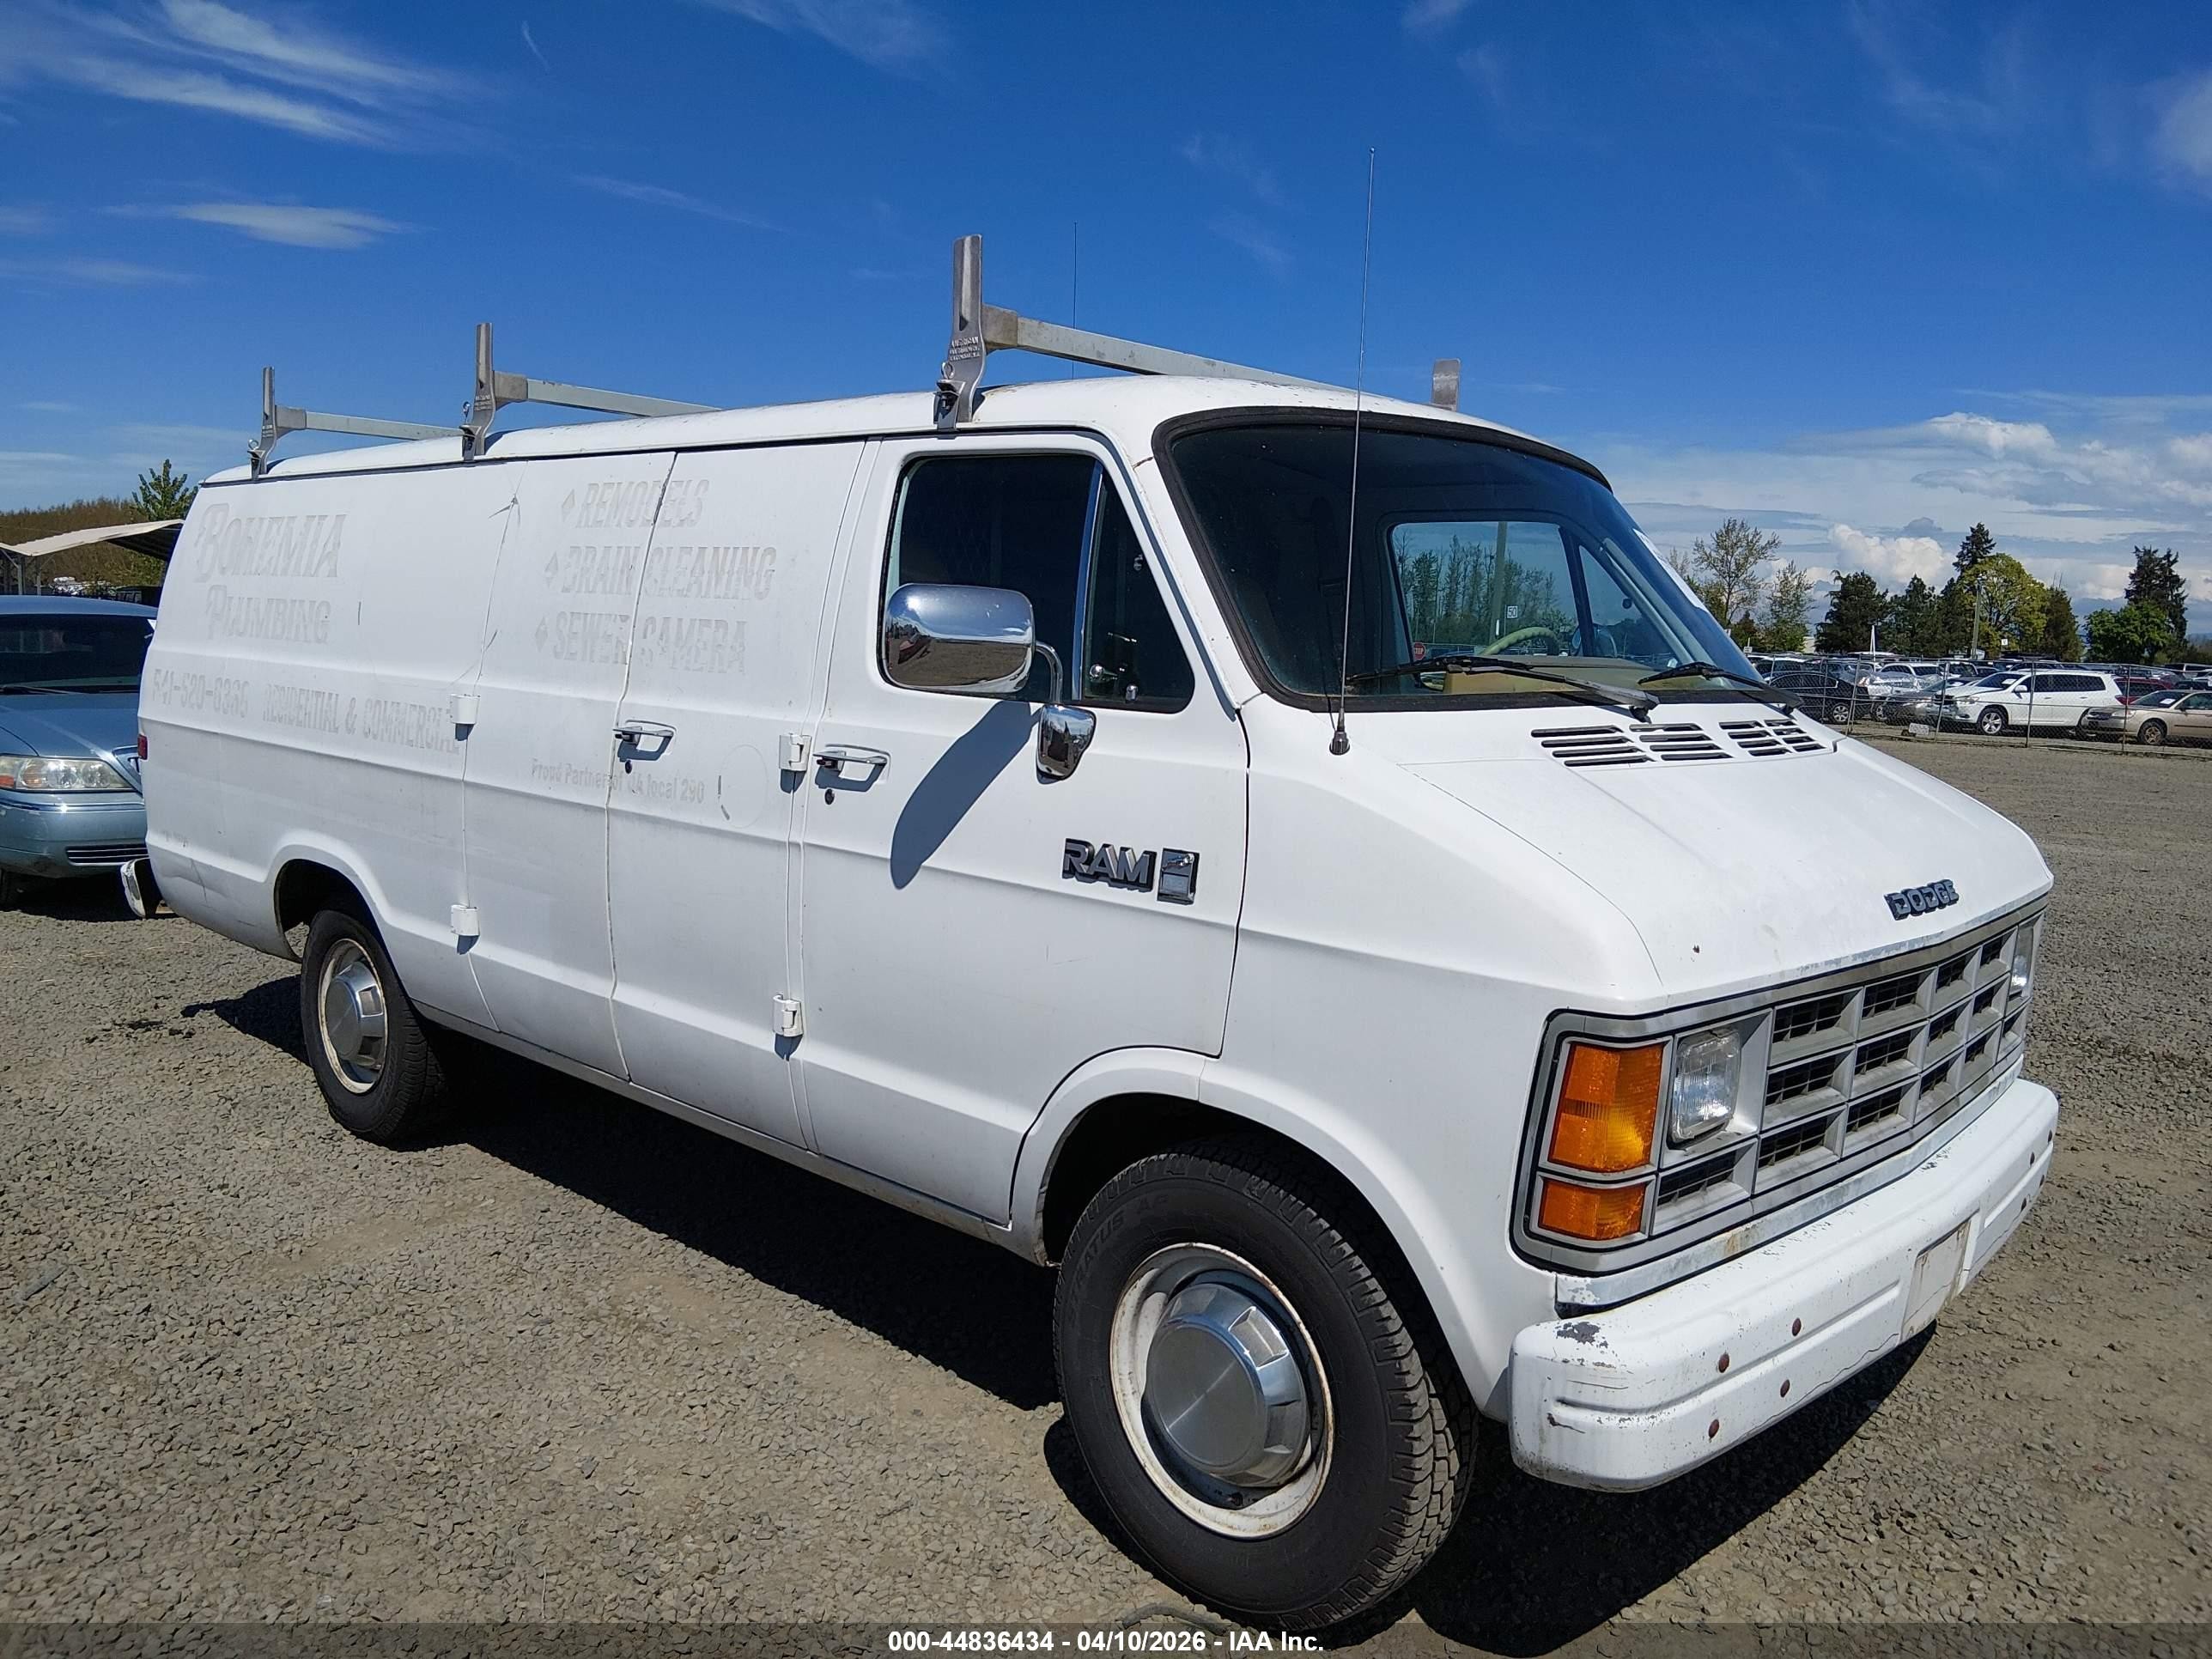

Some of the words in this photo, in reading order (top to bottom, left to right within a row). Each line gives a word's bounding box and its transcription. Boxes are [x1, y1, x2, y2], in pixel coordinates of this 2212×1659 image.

[575, 479, 710, 528] REMODELS
[192, 502, 347, 583] BOHEMIA
[562, 546, 641, 595] DRAIN
[643, 546, 777, 600] CLEANING
[206, 584, 331, 645] PLUMBING
[552, 611, 631, 665] SEWER
[640, 616, 747, 674] CAMERA
[345, 696, 357, 736] &
[1062, 838, 1158, 891] RAM
[1884, 879, 1959, 921] DODGE
